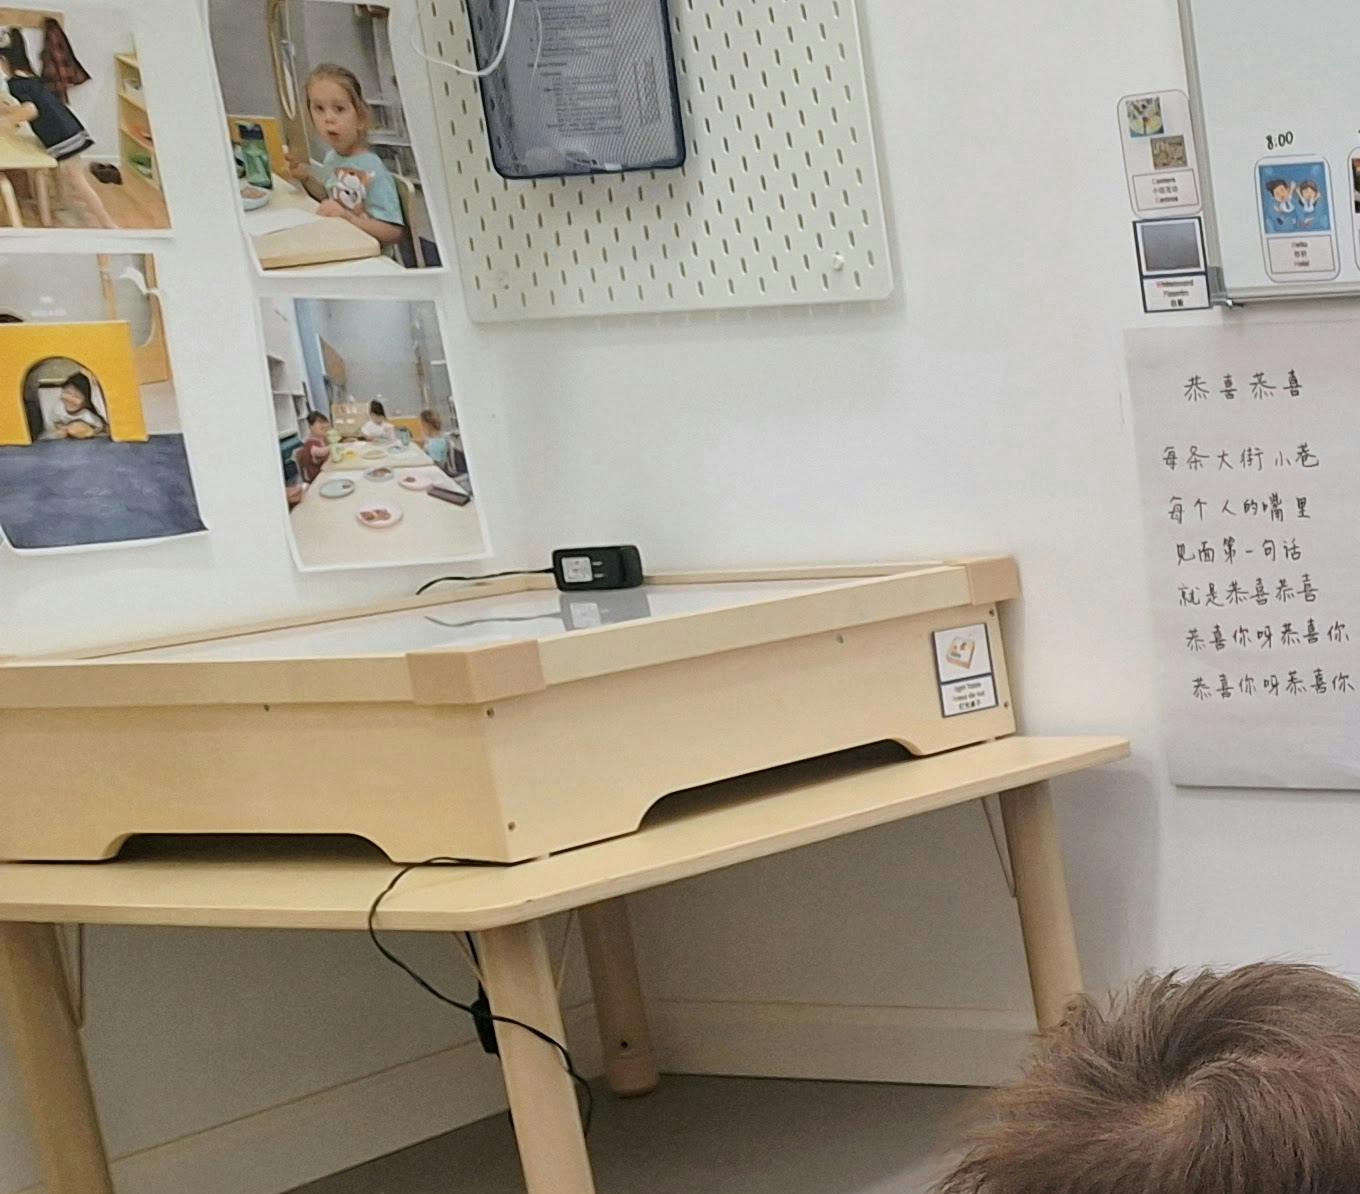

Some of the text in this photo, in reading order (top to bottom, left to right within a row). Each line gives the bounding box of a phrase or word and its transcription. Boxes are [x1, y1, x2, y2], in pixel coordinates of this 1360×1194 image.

[1265, 131, 1294, 150] 8:00
[1183, 368, 1303, 402] 恭喜恭喜
[1162, 441, 1320, 471] 每条大街小巷
[1175, 536, 1302, 566] 见面第一句话
[1178, 573, 1320, 607] 就是恭喜恭喜
